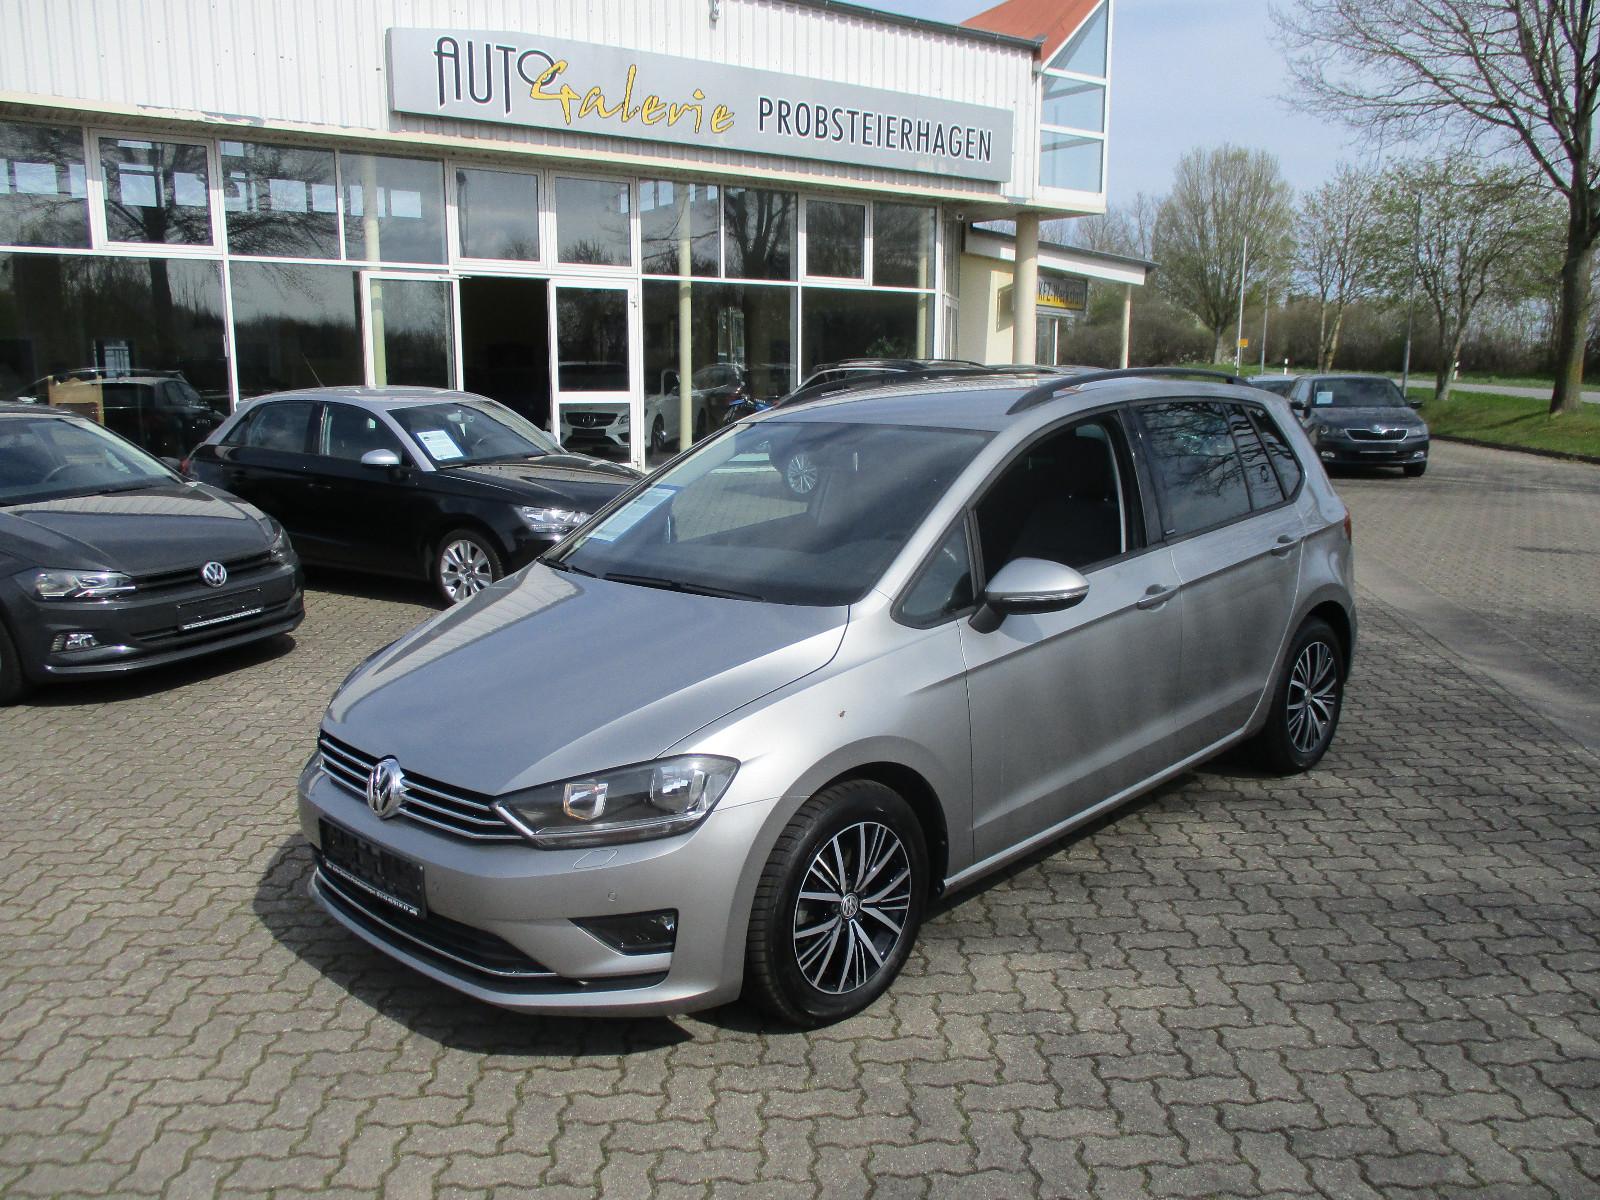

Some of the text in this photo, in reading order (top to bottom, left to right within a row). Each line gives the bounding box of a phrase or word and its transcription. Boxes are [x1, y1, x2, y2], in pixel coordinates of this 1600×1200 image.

[433, 36, 993, 162] AUTO Galerie PROBSTEIERHAGEN
